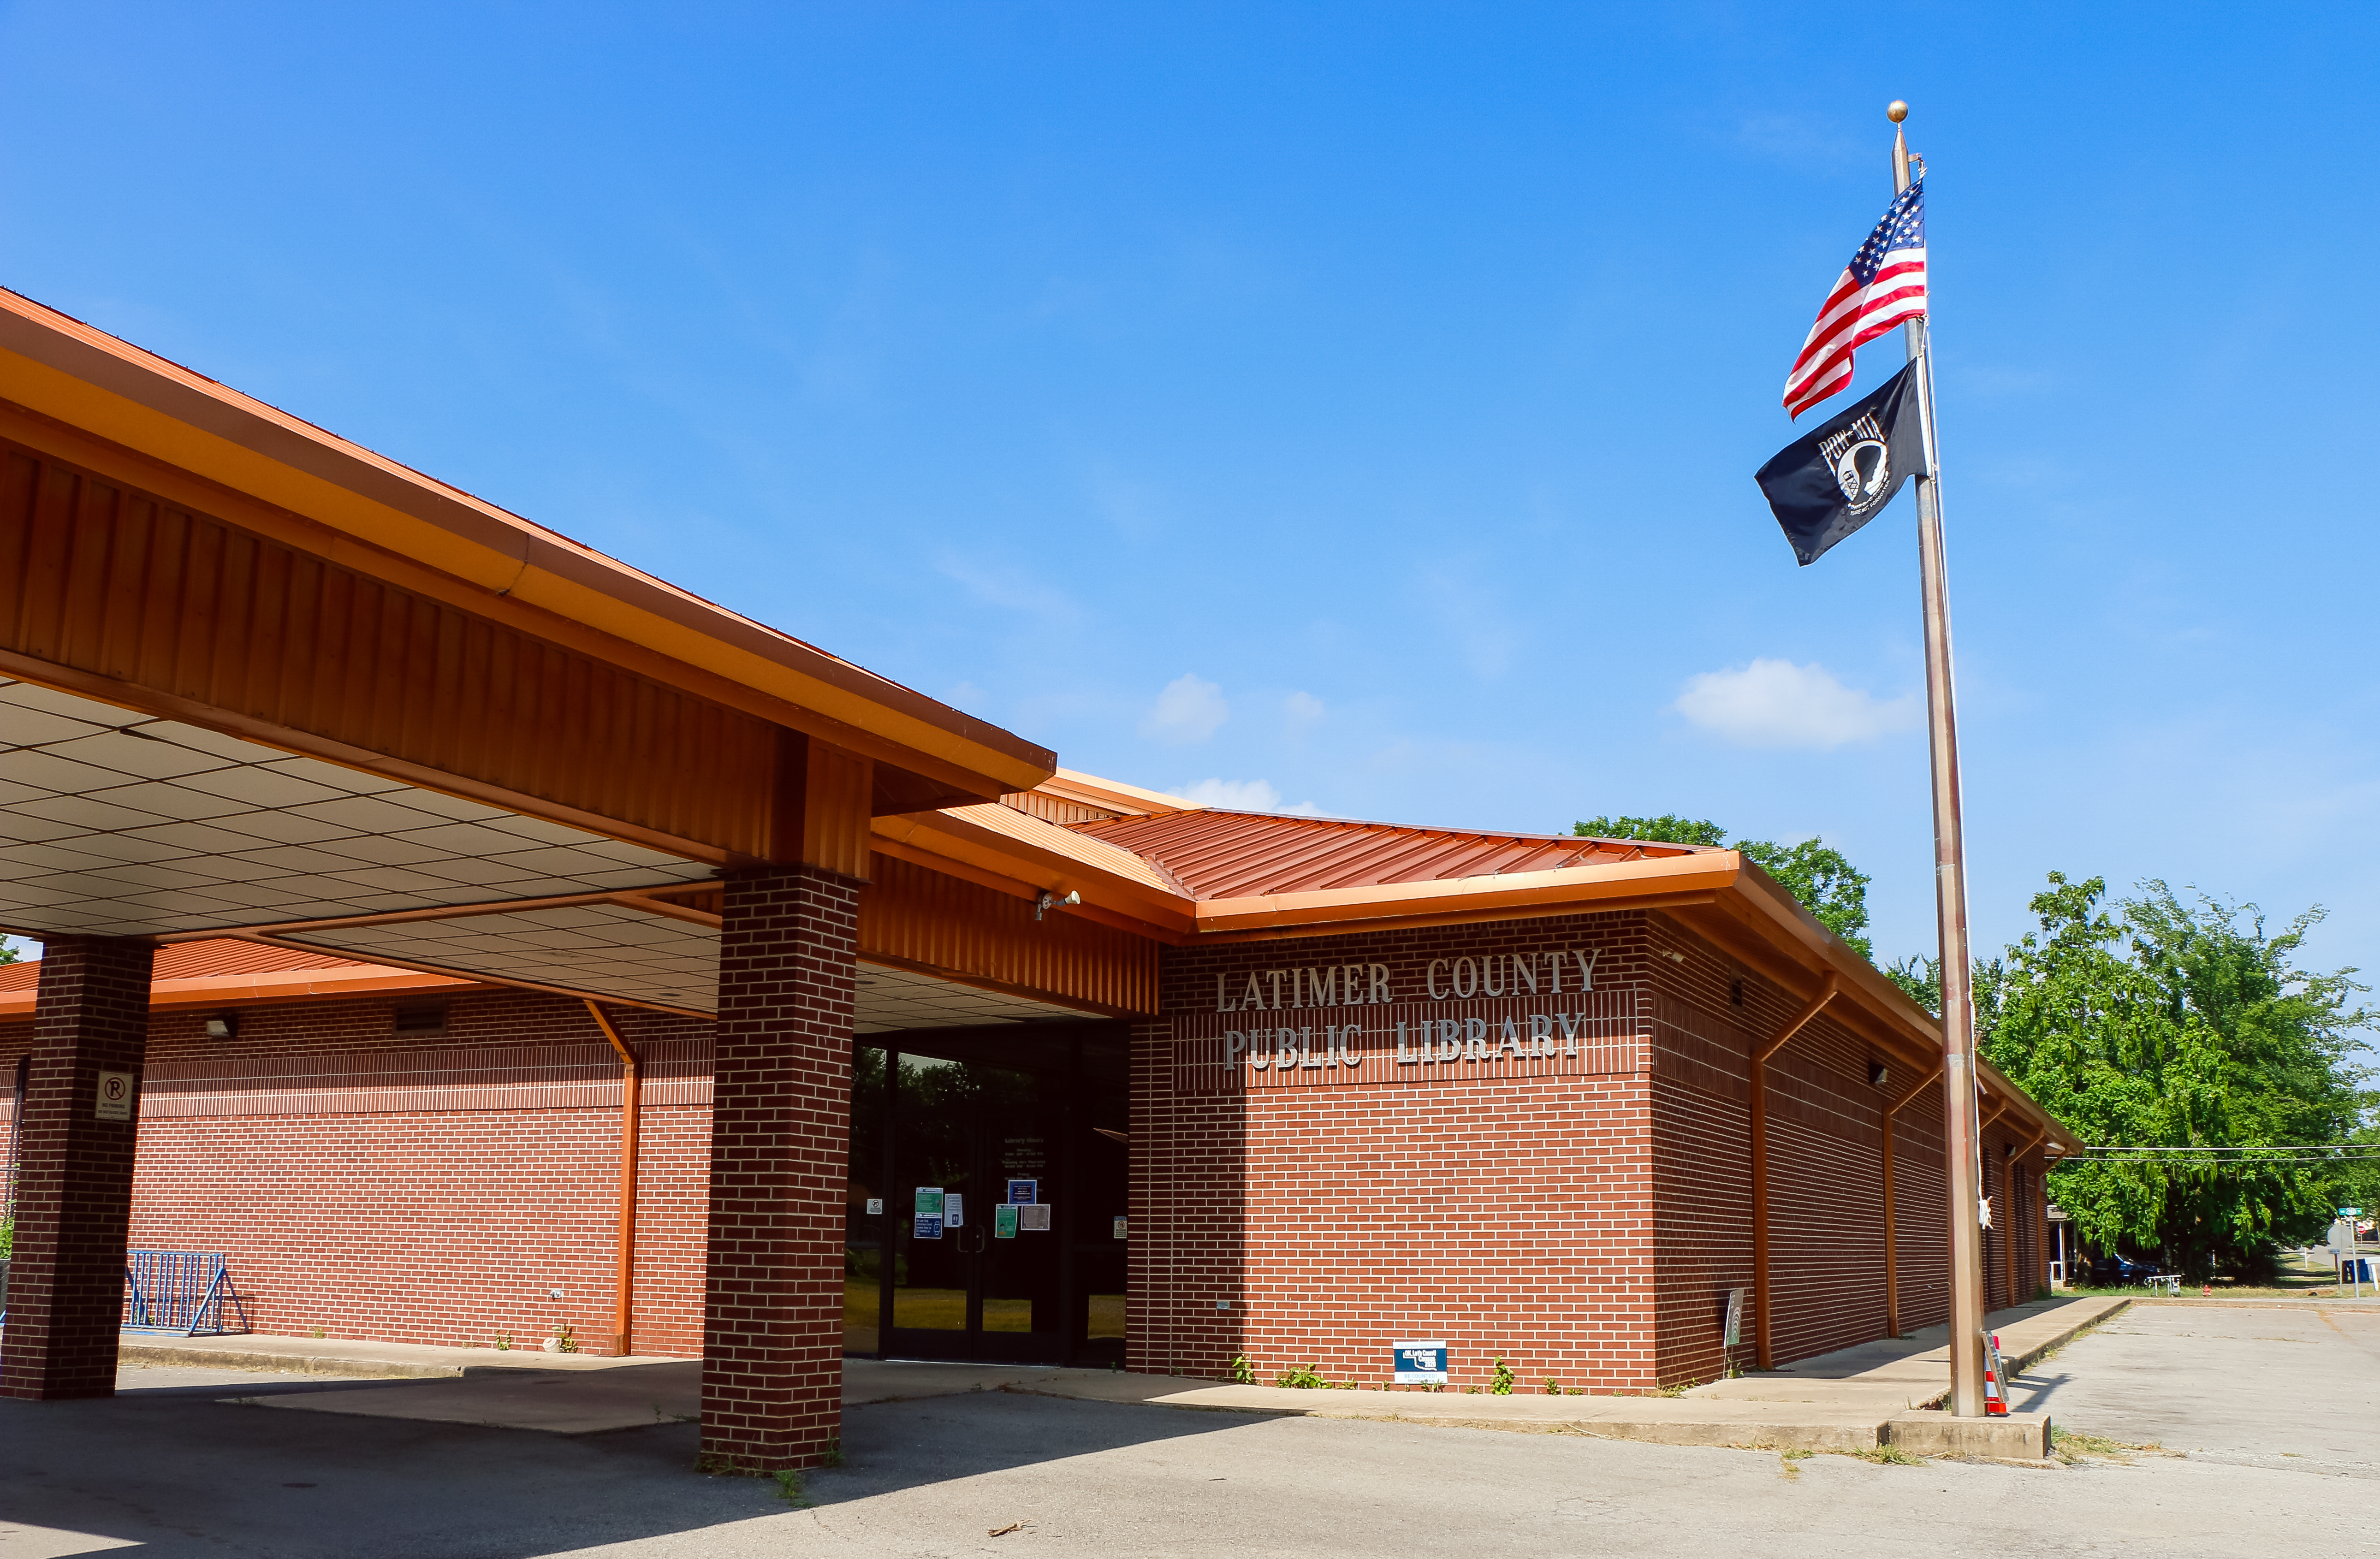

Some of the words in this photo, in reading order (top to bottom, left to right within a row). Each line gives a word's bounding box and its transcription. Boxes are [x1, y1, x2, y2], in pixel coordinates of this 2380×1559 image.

[1818, 430, 1850, 477] POW
[1851, 412, 1885, 443] MIA
[1216, 963, 1393, 1012] LATIMER
[1427, 948, 1602, 1000] COUNTY
[1224, 1024, 1362, 1071] PUBLIC
[1395, 1012, 1585, 1063] LIBRARY
